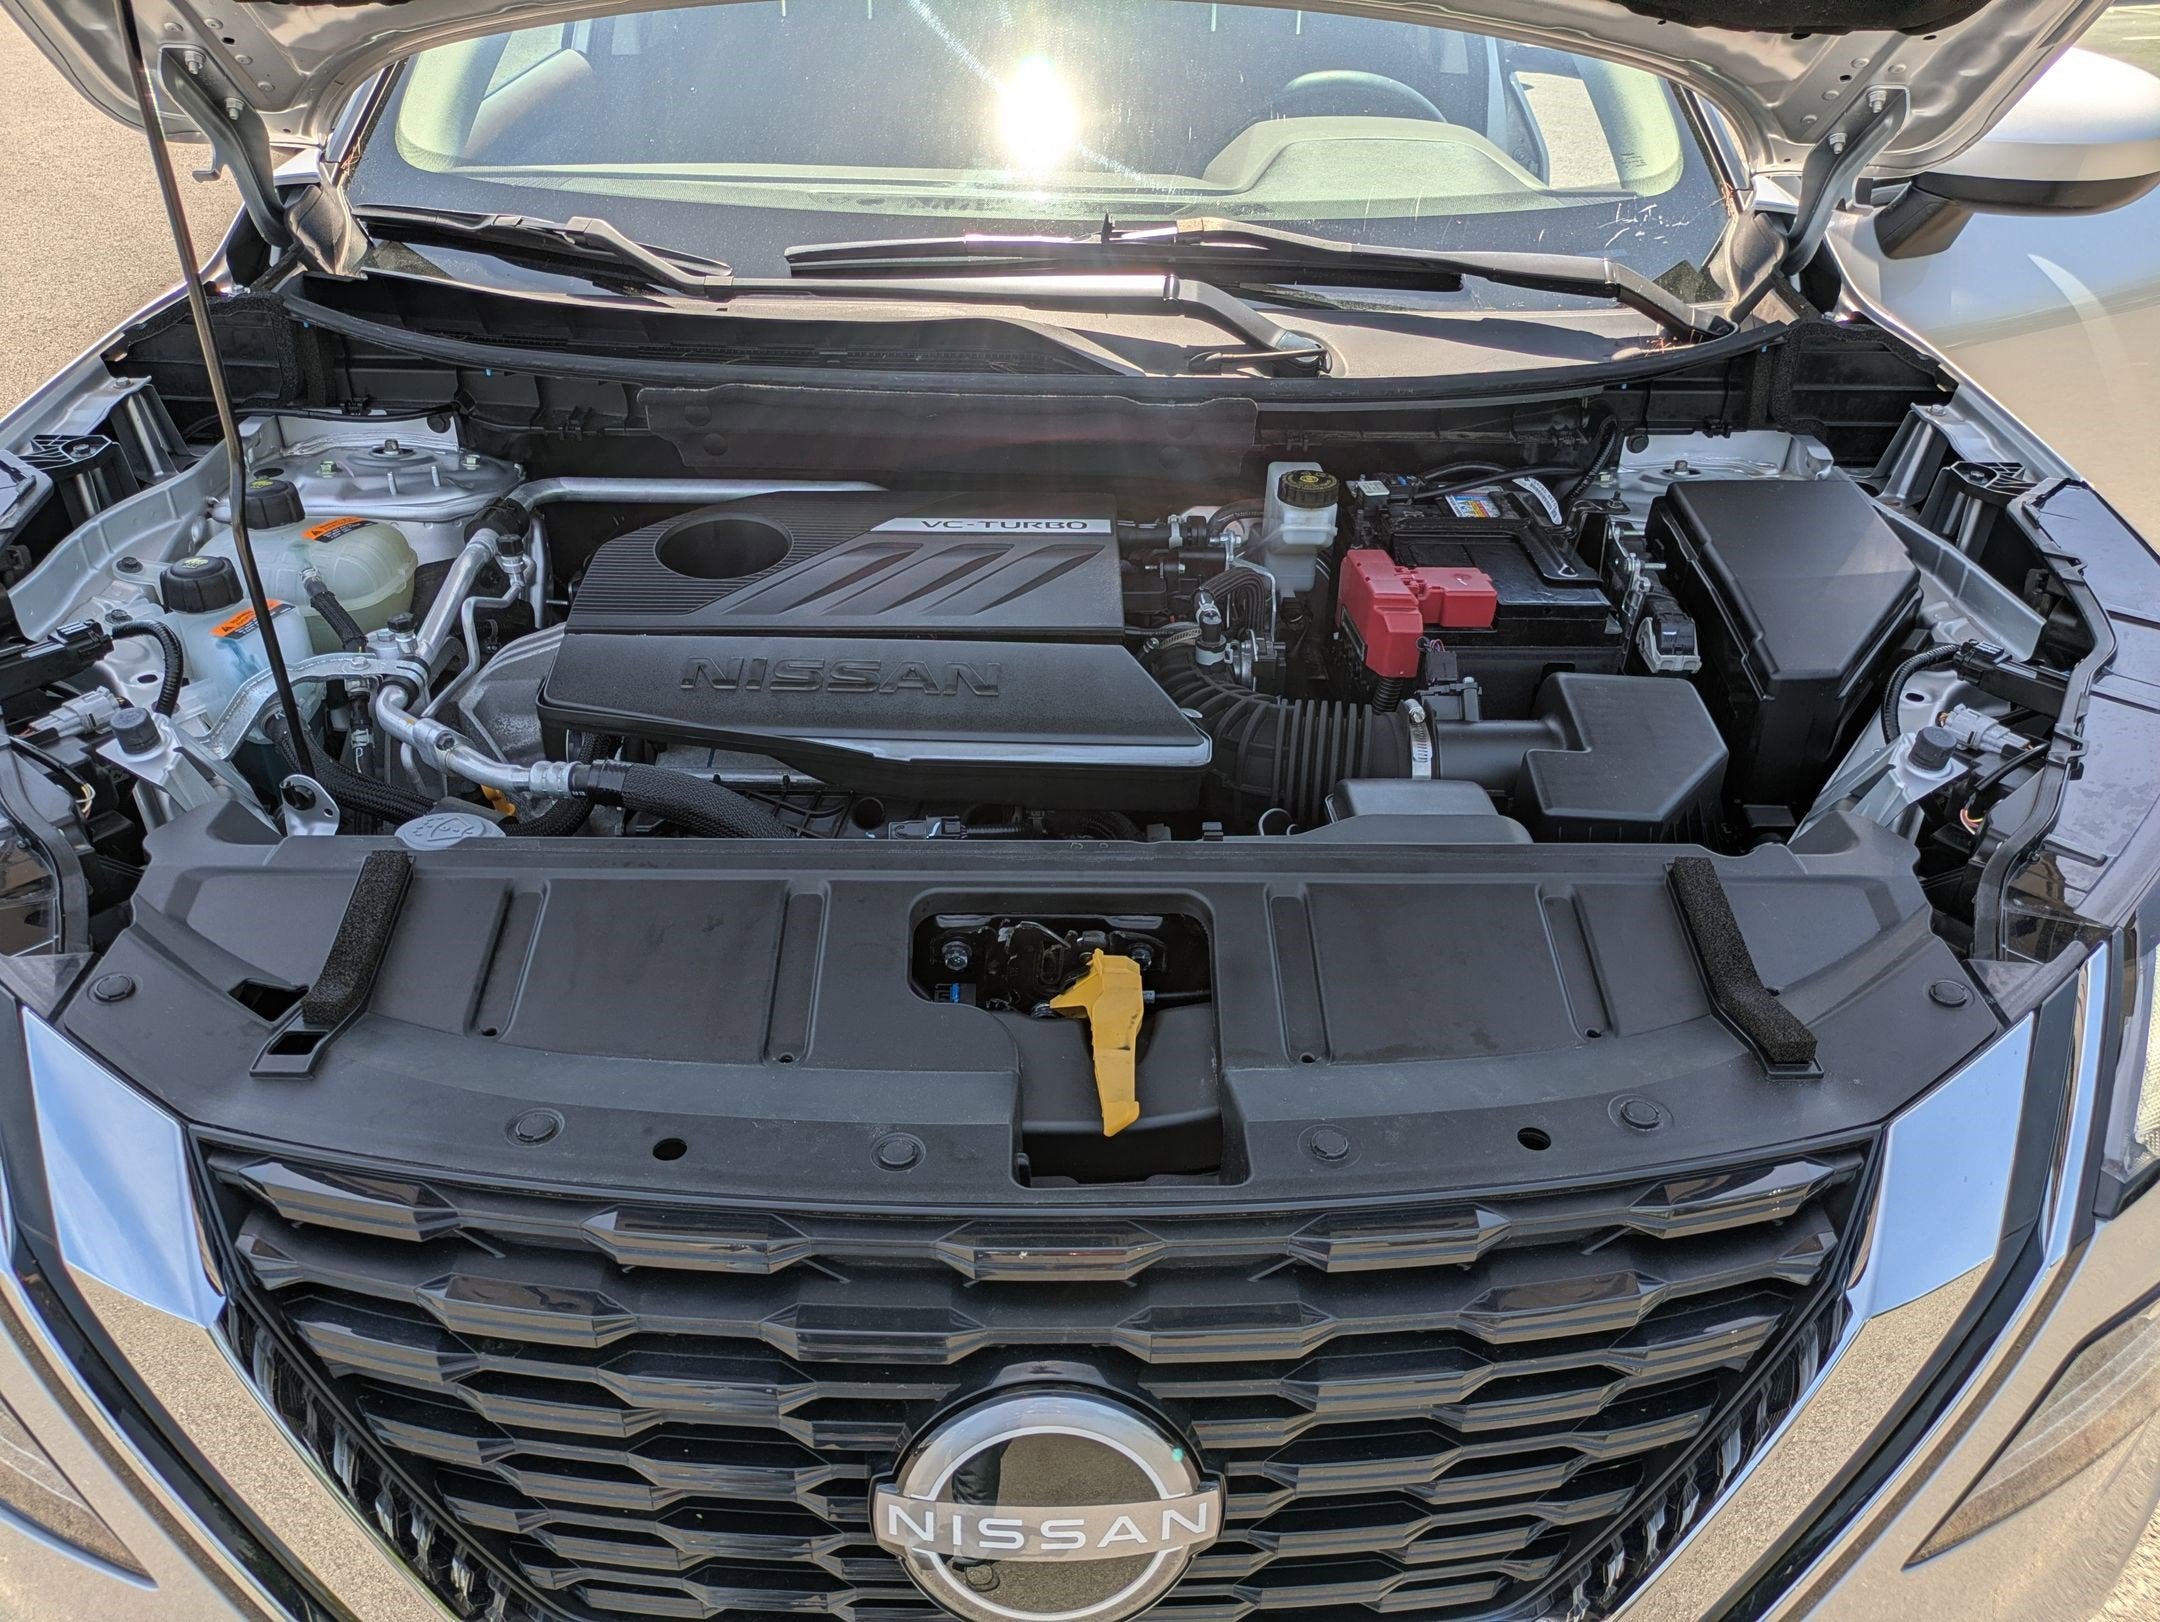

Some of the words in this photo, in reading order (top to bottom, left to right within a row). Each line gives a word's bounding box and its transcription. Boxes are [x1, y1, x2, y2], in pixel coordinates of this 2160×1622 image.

[921, 520, 1088, 530] VC-TURBO
[680, 657, 1000, 696] NISSAN
[888, 1502, 1207, 1550] NISSAN
